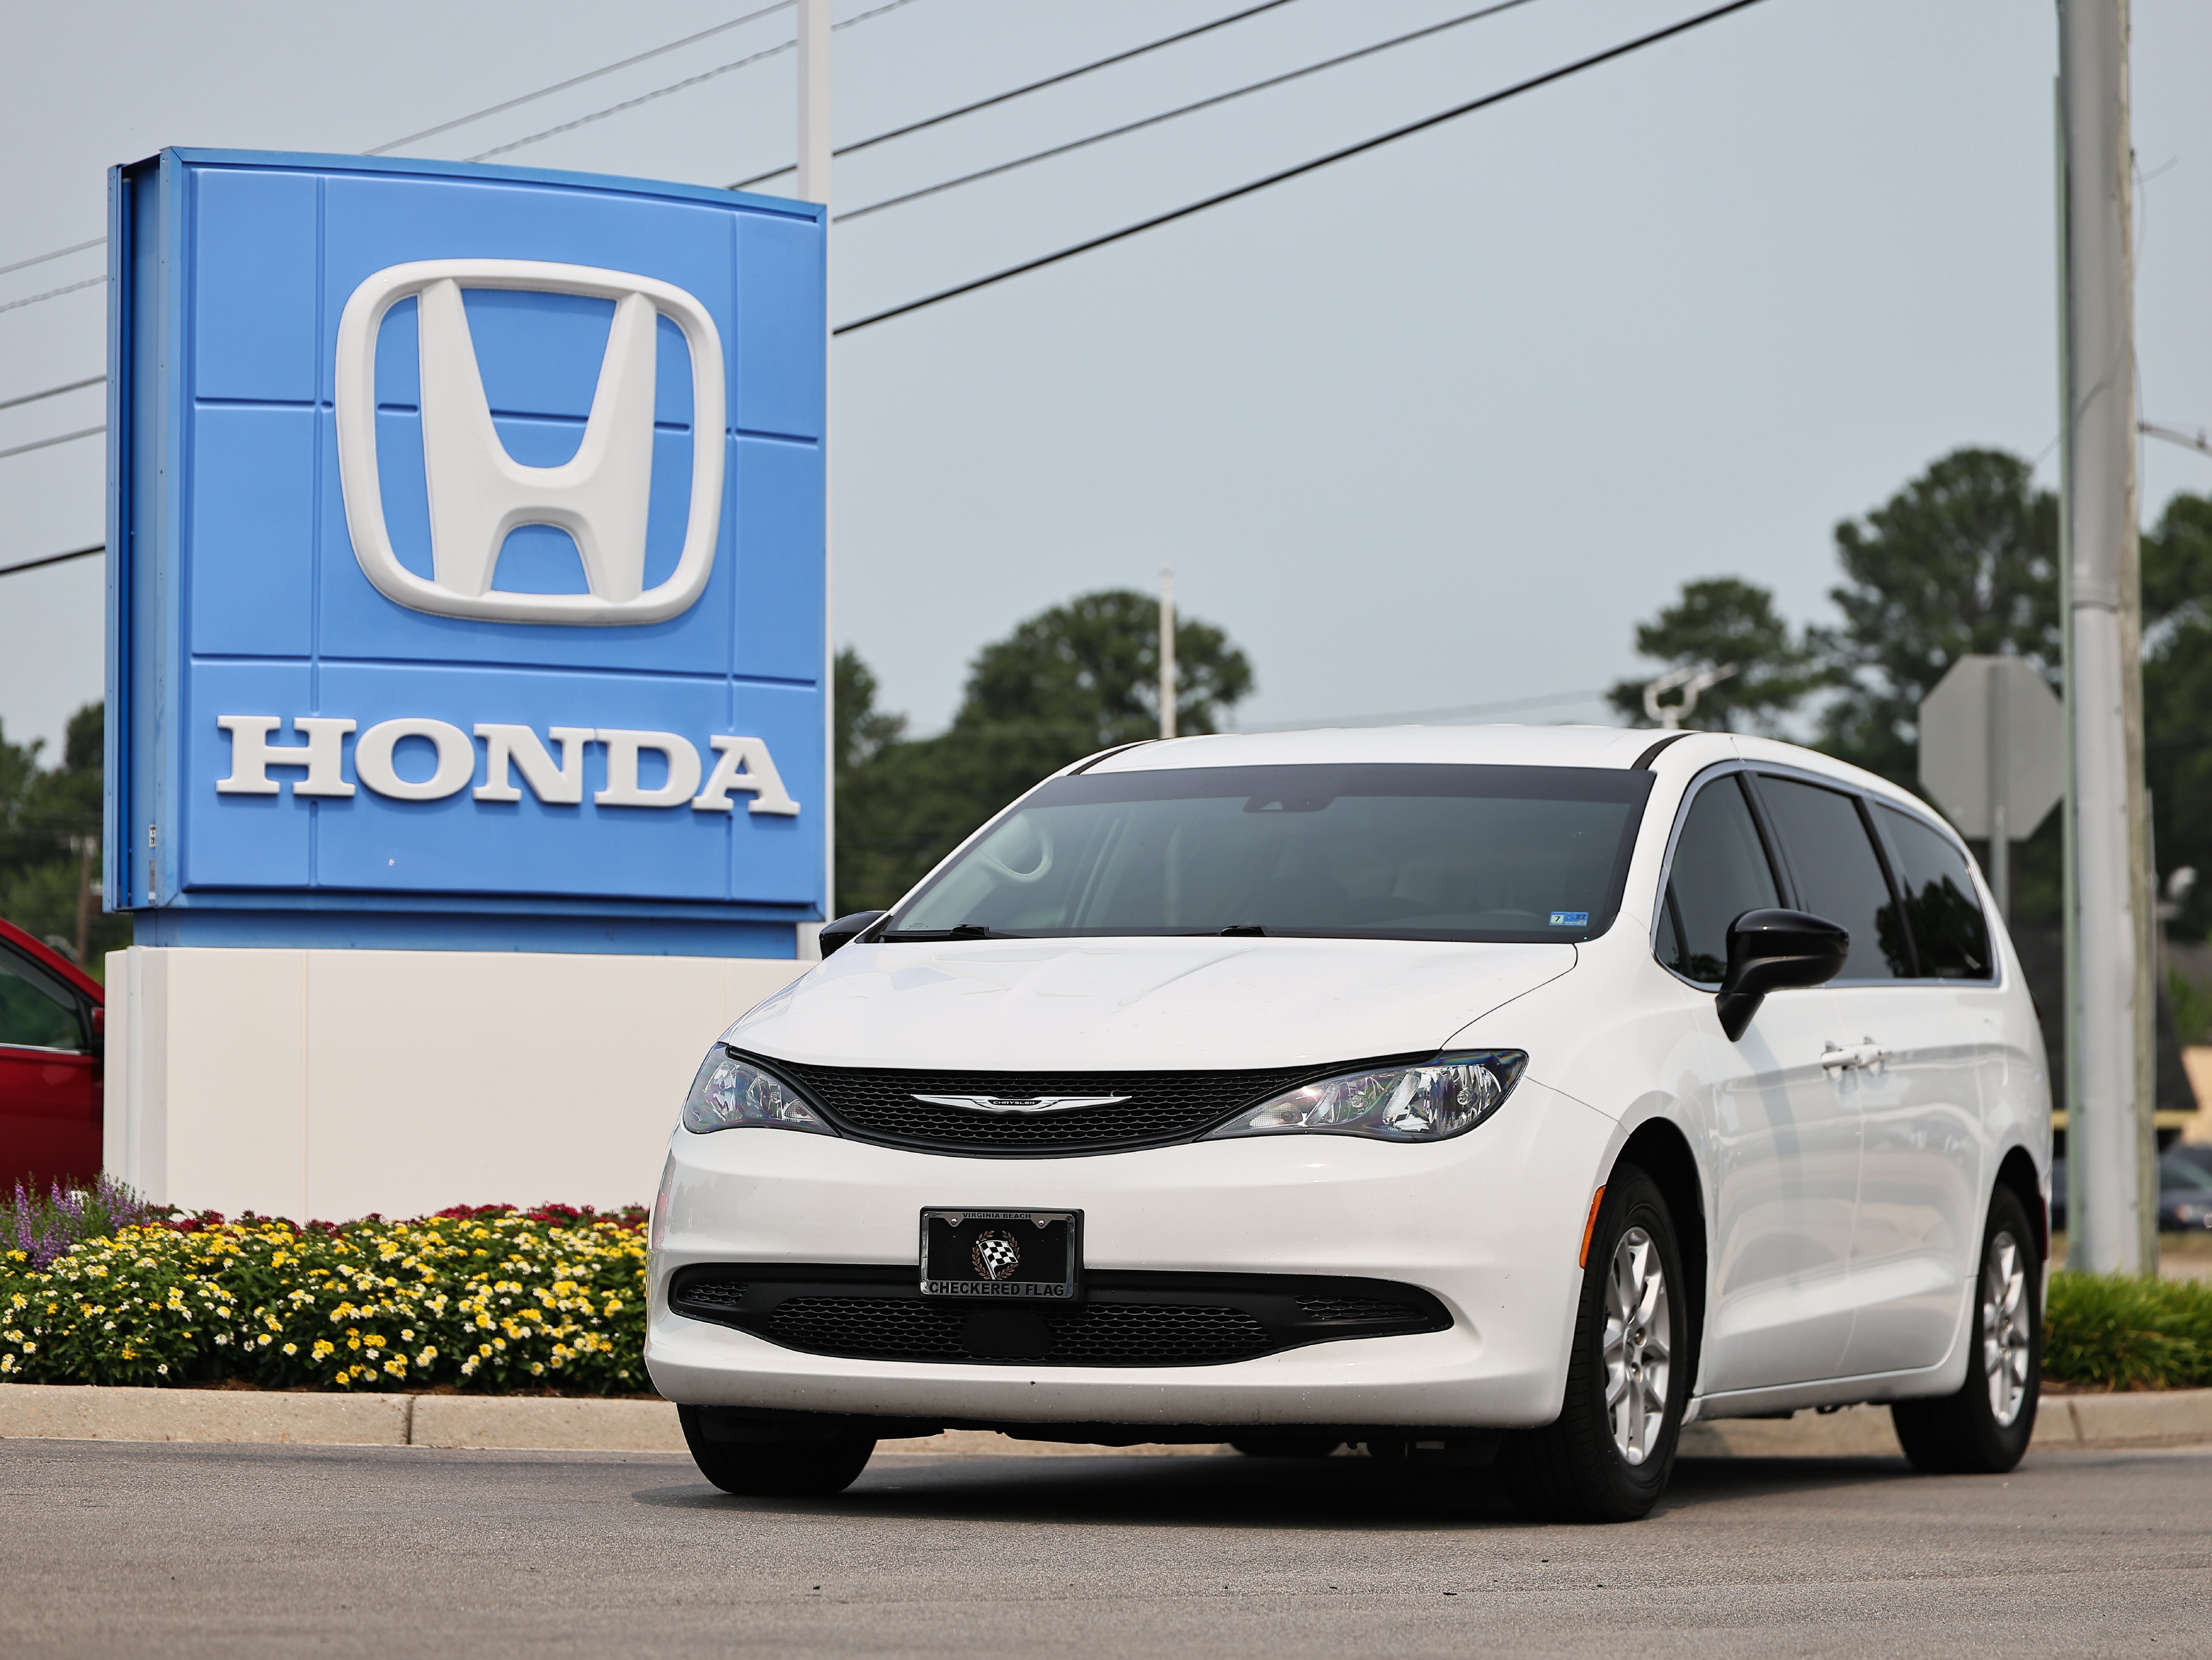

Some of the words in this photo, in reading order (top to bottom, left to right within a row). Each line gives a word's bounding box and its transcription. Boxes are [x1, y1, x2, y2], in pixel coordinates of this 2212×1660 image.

[216, 714, 801, 816] HONDA
[929, 1281, 1020, 1295] CHECKERED
[1026, 1283, 1064, 1297] FLAG
